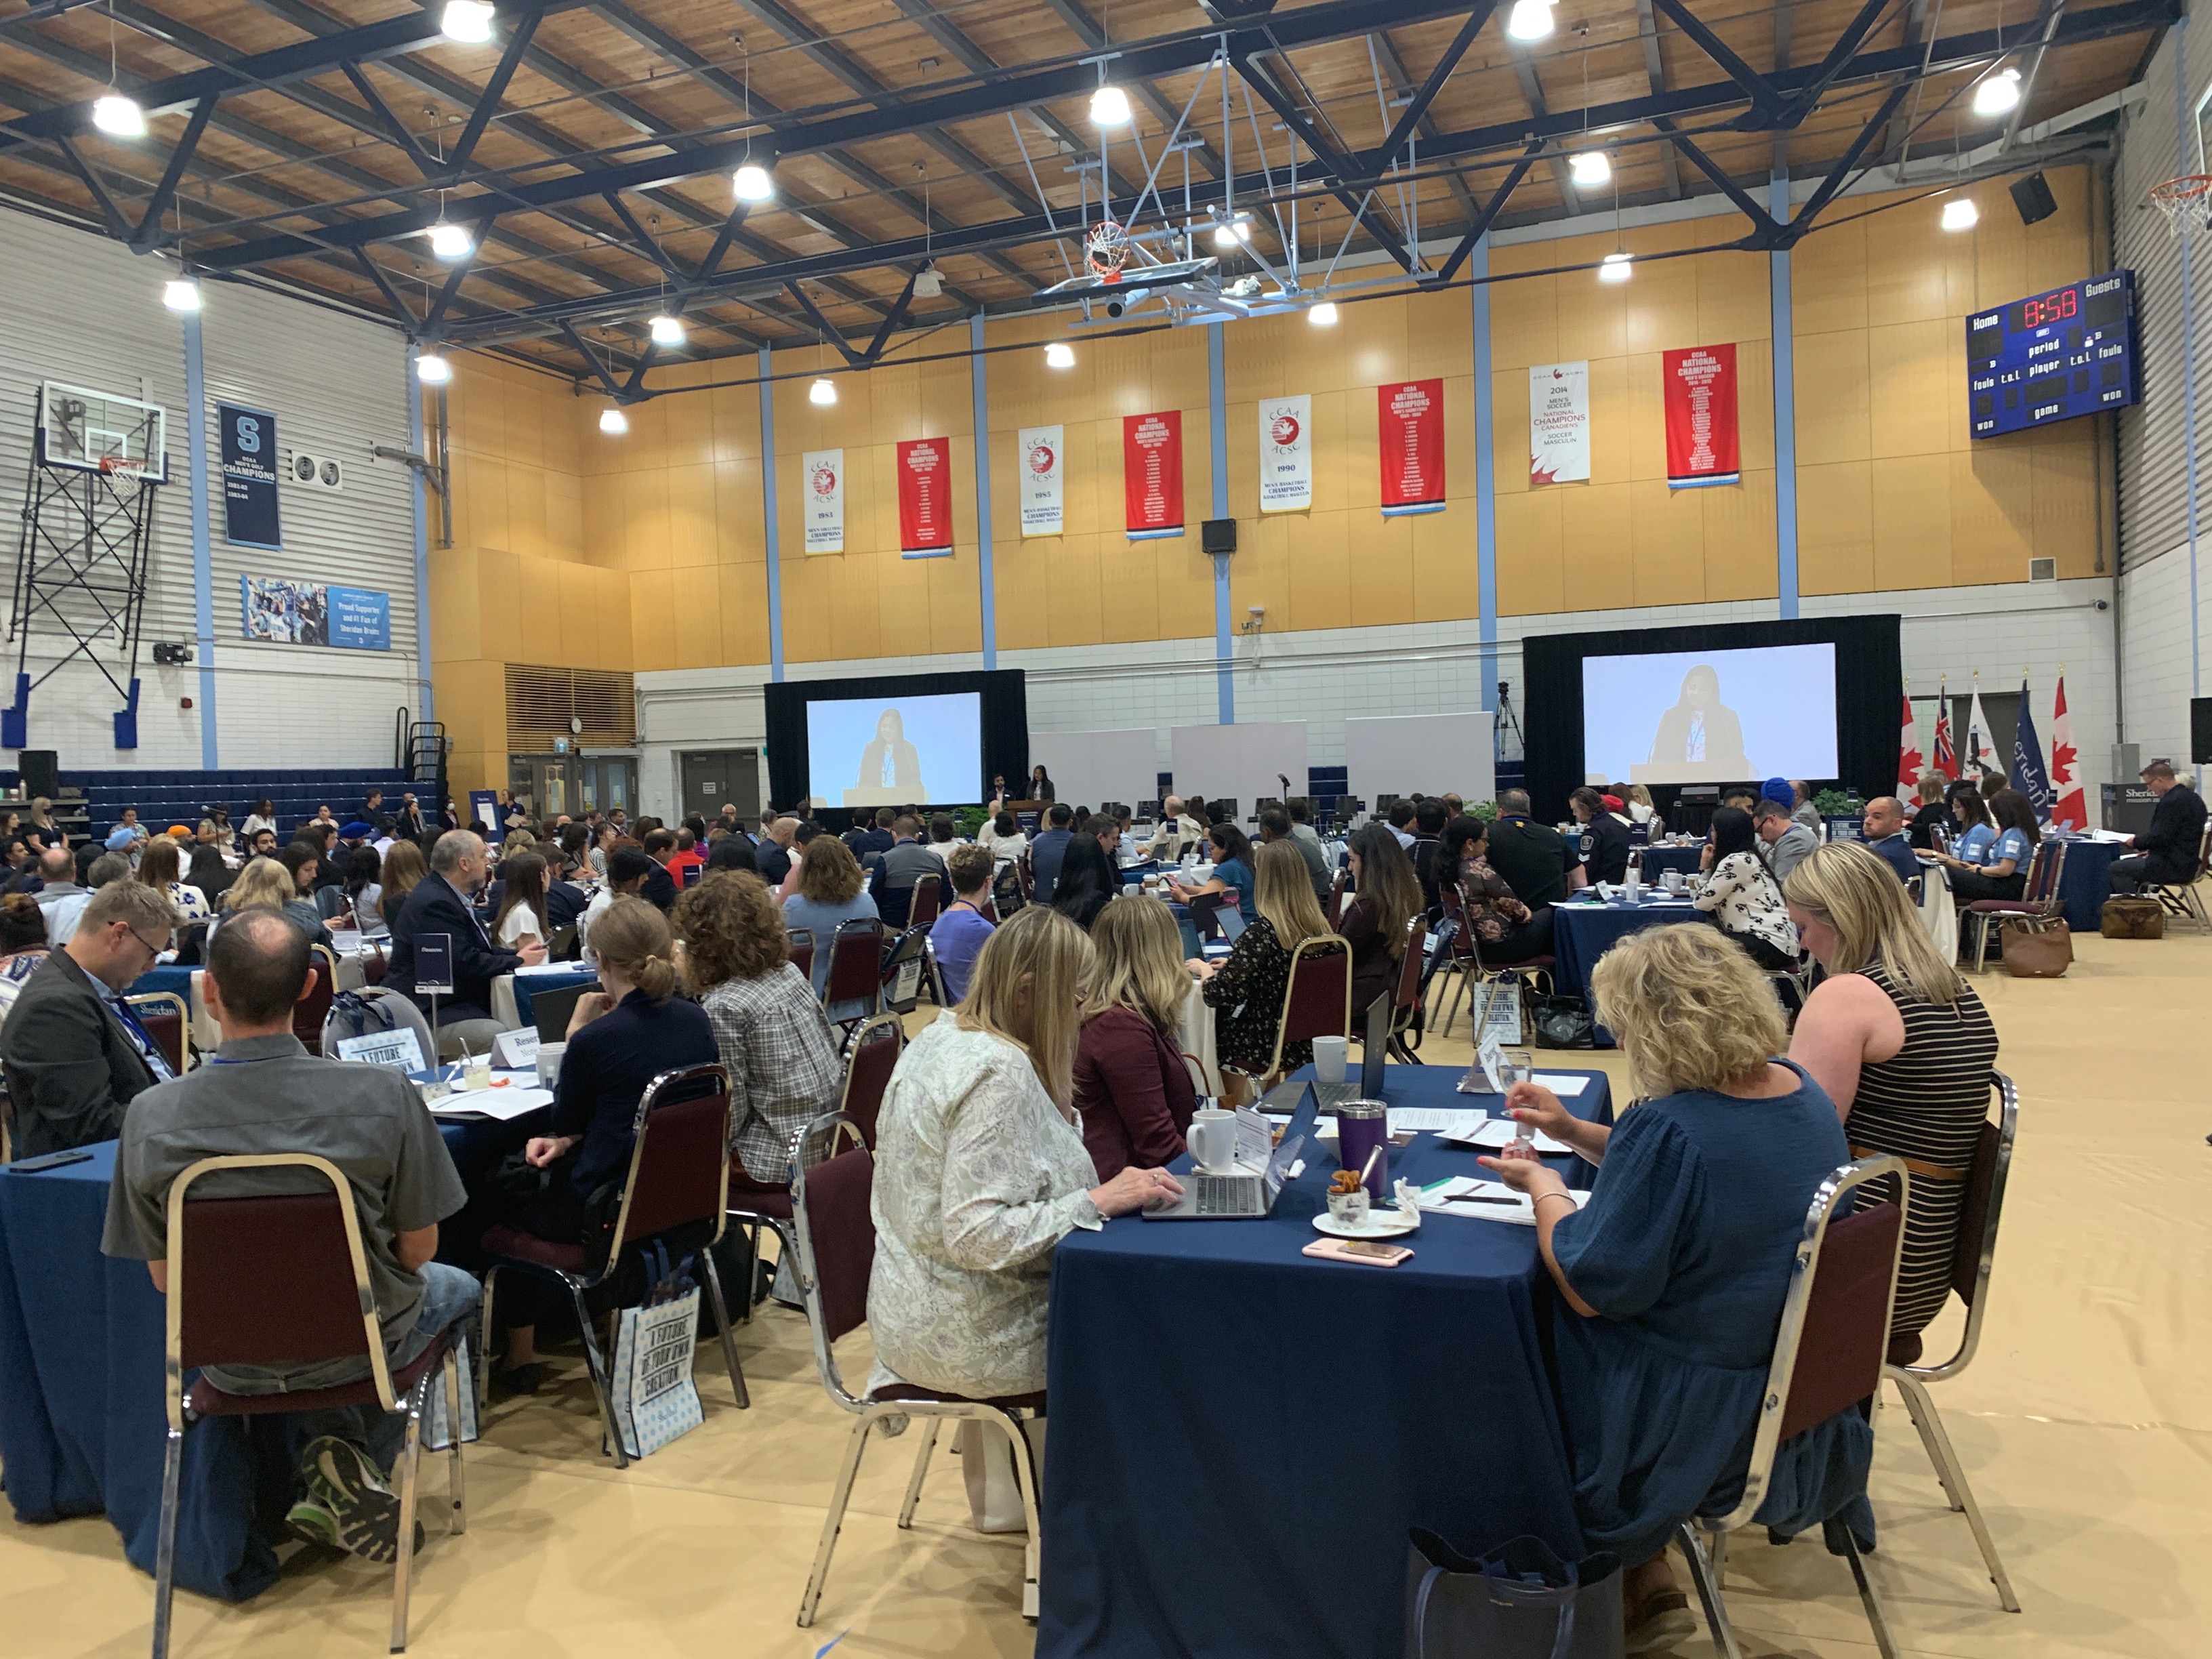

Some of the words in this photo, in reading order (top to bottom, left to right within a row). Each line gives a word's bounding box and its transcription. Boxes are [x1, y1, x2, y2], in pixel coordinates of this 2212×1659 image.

[2085, 278, 2121, 298] Guests
[2024, 289, 2076, 329] 8:58
[1973, 314, 1999, 331] Home
[1692, 350, 1707, 359] CCAA
[2028, 339, 2060, 359] period
[2099, 344, 2122, 359] fouls
[1682, 356, 1717, 367] NATIONAL
[1678, 364, 1721, 377] CHAMPIONS
[2029, 360, 2060, 377] player
[1551, 386, 1568, 394] 2014
[1973, 377, 1994, 391] fouls
[1395, 391, 1425, 401] NATIONAL
[2103, 390, 2121, 402] won
[1391, 398, 1430, 410] CHAMPIONS
[1269, 407, 1299, 421] CCAA
[2034, 404, 2058, 419] game
[1534, 414, 1586, 426] CHAMPIONS
[1978, 420, 1994, 431] won
[1138, 422, 1166, 432] NATIONAL
[1541, 423, 1578, 431] CANADIENS
[237, 416, 260, 453] S
[1134, 429, 1170, 440] CHAMPIONS
[1027, 437, 1054, 450] CCAA
[1271, 442, 1300, 455] ACSC
[910, 448, 935, 457] NATIONAL
[907, 455, 939, 464] CHAMPIONS
[224, 464, 275, 481] CHAMPIONS
[811, 461, 835, 472] CCAA
[1277, 464, 1296, 472] 1990
[1029, 470, 1055, 483] ACSC
[1269, 485, 1305, 494] CHAMPIONS
[813, 493, 837, 504] ACSC
[338, 602, 354, 611] Proud
[361, 615, 371, 623] Fan
[340, 624, 363, 634] Sheridan
[364, 626, 380, 635] Bruins
[514, 1036, 537, 1047] Reser
[368, 1047, 401, 1063] FUTURE
[657, 1319, 687, 1343] FUTURE
[641, 1355, 651, 1376] OF
[651, 1347, 671, 1369] YOUR
[672, 1339, 690, 1360] OWN
[645, 1365, 680, 1397] CREATION
